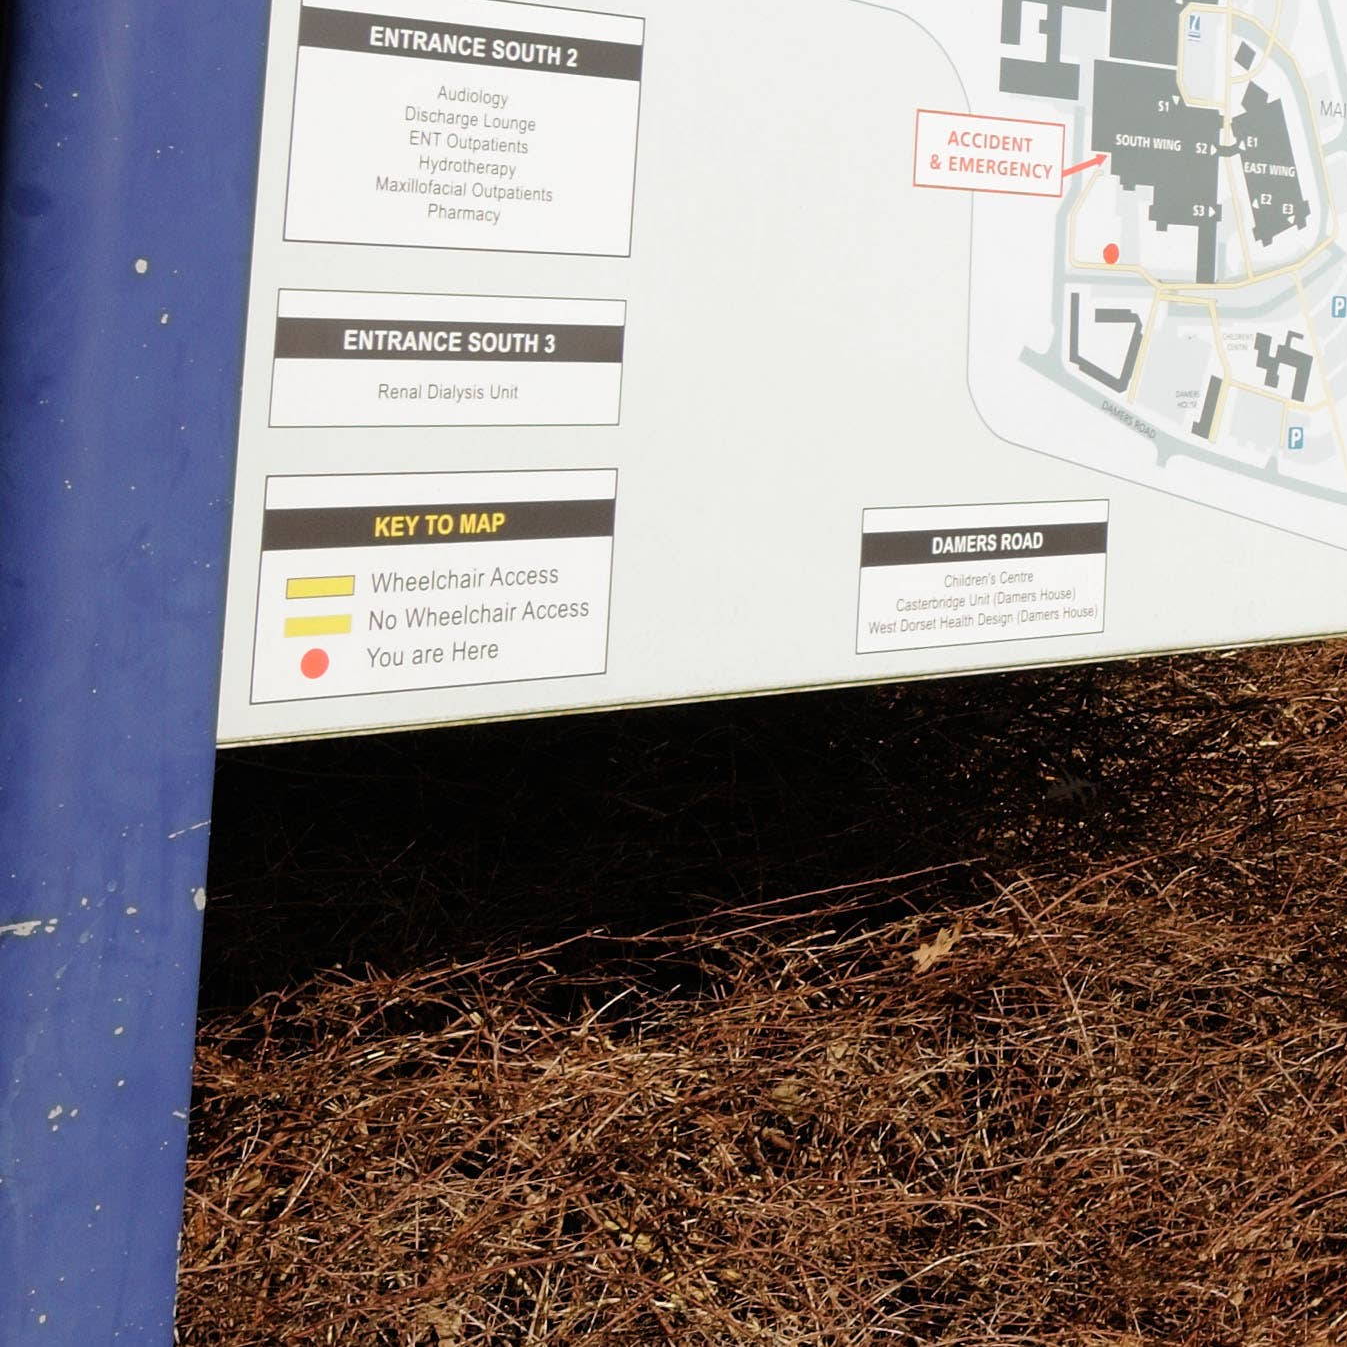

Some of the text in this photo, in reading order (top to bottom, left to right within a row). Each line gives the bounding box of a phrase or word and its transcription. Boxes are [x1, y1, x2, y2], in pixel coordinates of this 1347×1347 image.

[369, 25, 577, 67] ENTRANCE SOUTH 2
[436, 84, 508, 109] Audiology
[1158, 100, 1170, 112] S1
[404, 105, 536, 134] Discharge Lounge
[409, 129, 528, 154] ENT Outpatients
[948, 130, 1033, 153] ACCIDENT
[1115, 133, 1181, 153] SOUTH WING
[1195, 142, 1208, 155] S2
[1247, 136, 1258, 148] E1
[418, 155, 516, 179] Hydrotherapy
[930, 153, 1053, 180] & EMERGENCY
[1244, 161, 1296, 178] EAST WING
[375, 175, 552, 202] Maxillofacial Outpatients
[1261, 194, 1272, 205] E2
[427, 202, 500, 225] Pharmacy
[1193, 205, 1205, 217] S3
[1282, 203, 1294, 215] E3
[343, 329, 555, 353] ENTRANCE SOUTH 3
[377, 383, 518, 403] Renal Dialysis Unit
[374, 512, 505, 537] KEY TO MAP
[931, 531, 1043, 554] DAMERS ROAD
[371, 566, 558, 593] Wheelchair Access
[943, 570, 1033, 588] Children's Centre
[895, 587, 1075, 612] Casterbridge Unit (Damers House)
[368, 600, 589, 630] No Wheelchair Access
[868, 607, 1097, 634] West Dorset Health Design (Damers House)
[366, 640, 498, 667] You are Here
